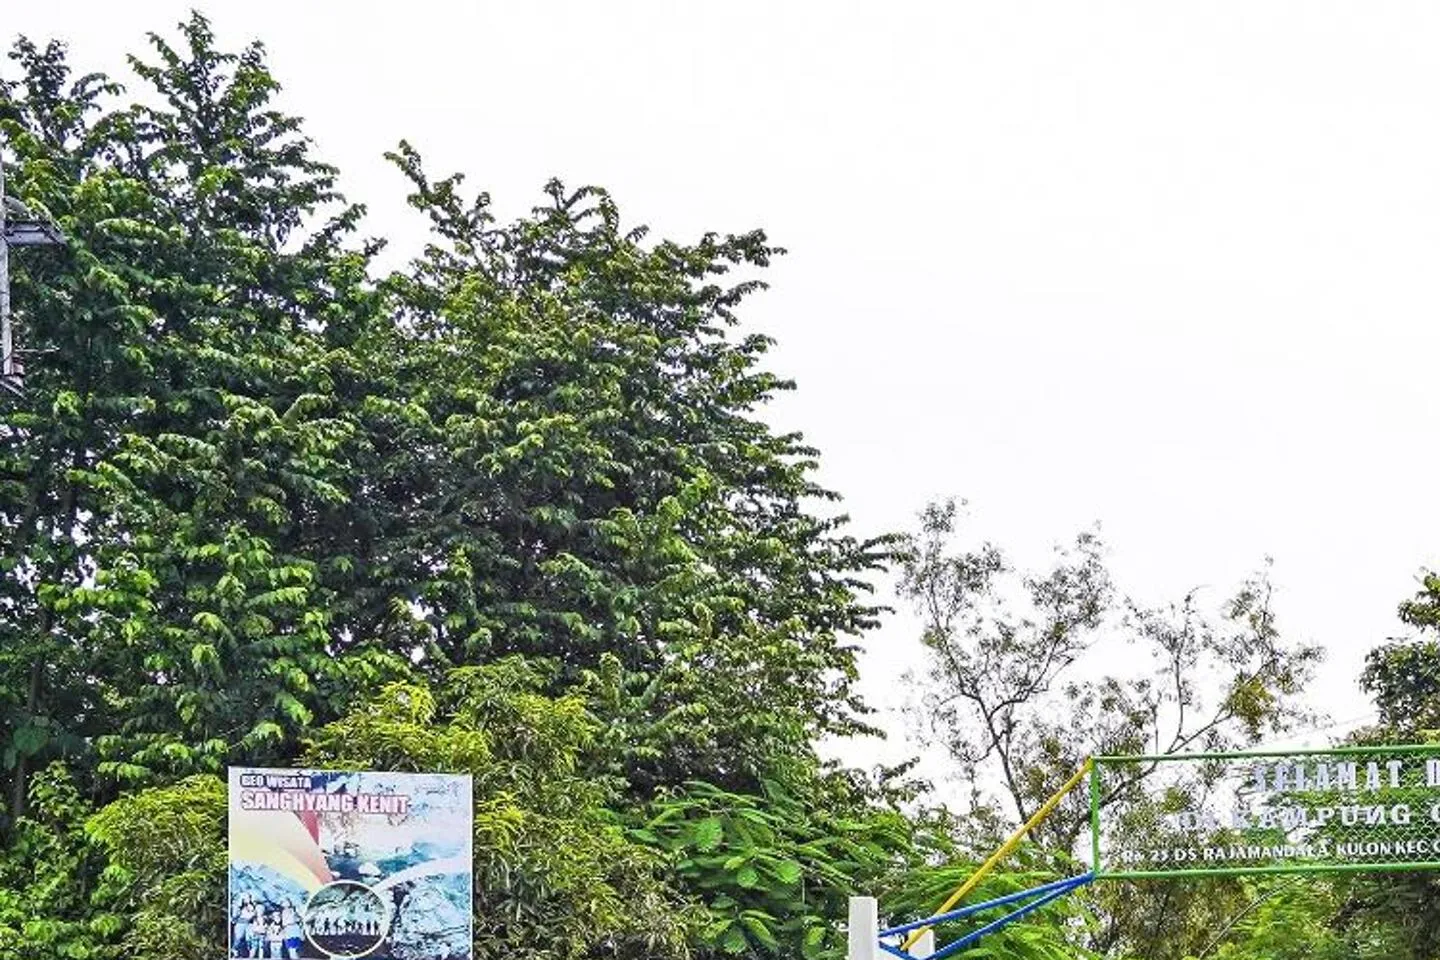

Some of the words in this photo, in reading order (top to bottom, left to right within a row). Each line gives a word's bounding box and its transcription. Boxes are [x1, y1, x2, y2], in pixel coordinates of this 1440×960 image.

[266, 776, 312, 790] WISATA
[242, 790, 356, 812] SANGHYANG
[357, 794, 410, 814] KENIT
[1174, 847, 1198, 861] DS
[1337, 842, 1392, 856] KULON
[1394, 840, 1428, 854] KEC
